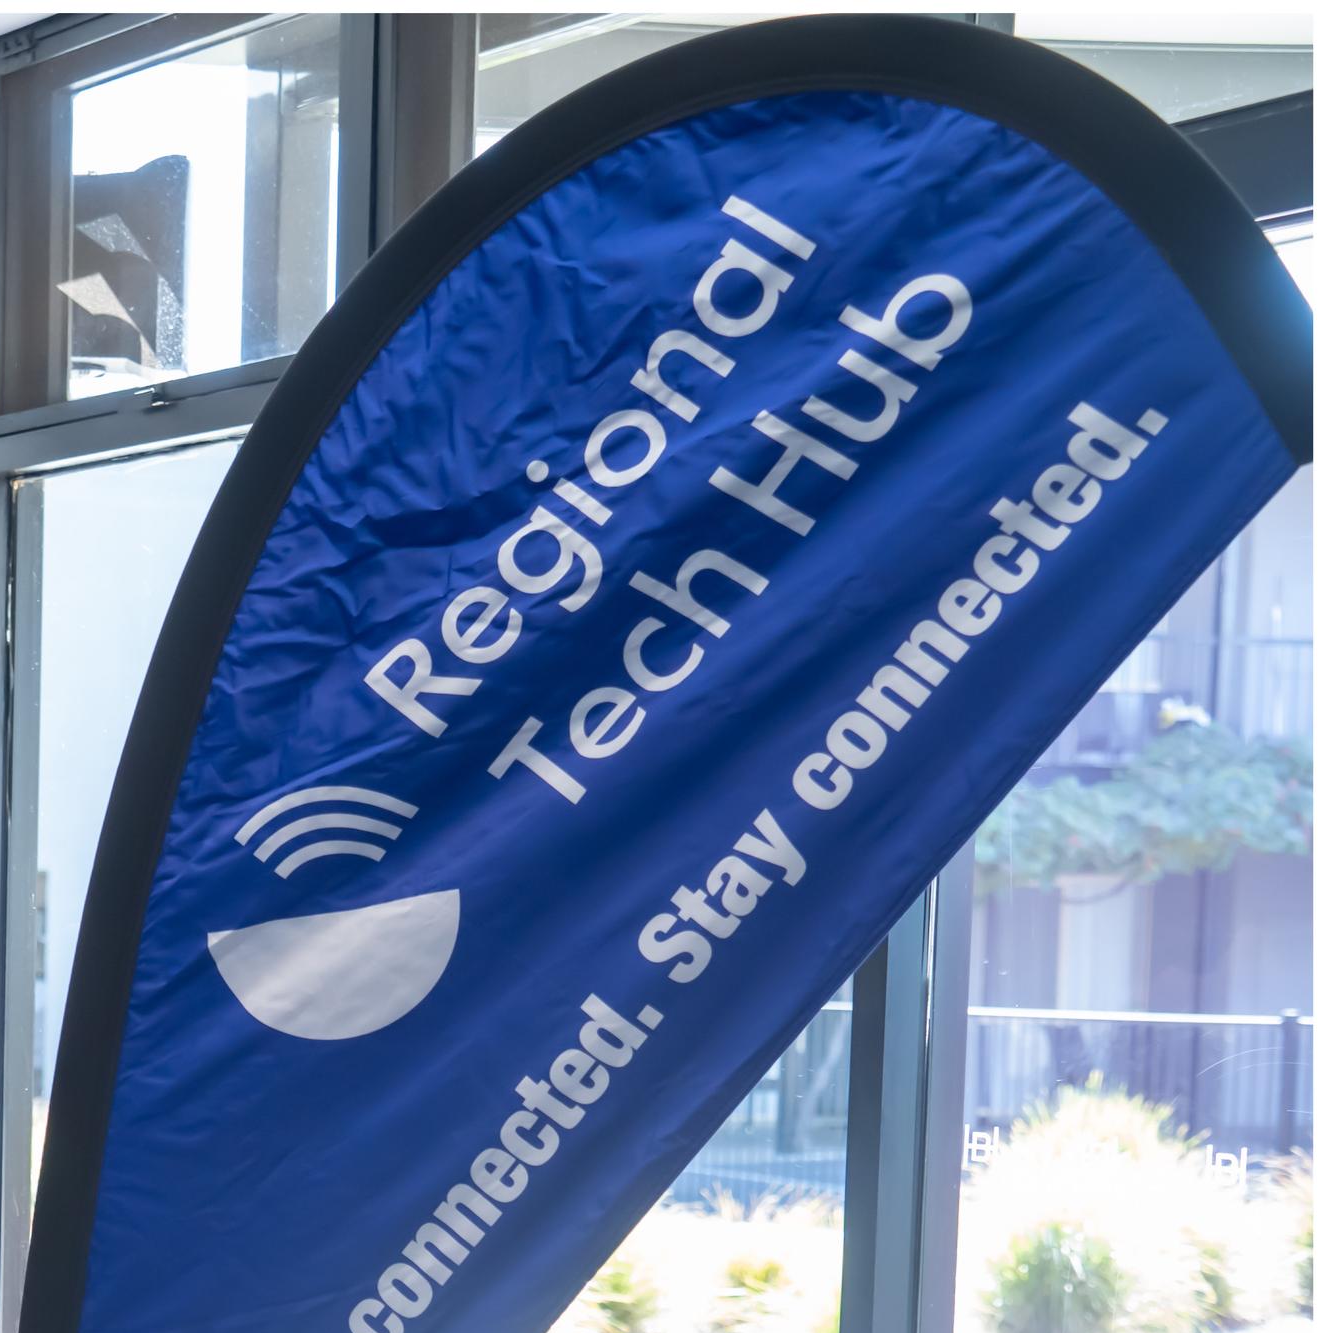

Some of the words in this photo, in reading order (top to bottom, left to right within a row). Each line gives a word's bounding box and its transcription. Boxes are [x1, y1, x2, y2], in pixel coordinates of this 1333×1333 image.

[363, 195, 818, 740] Regional
[488, 547, 771, 806] Tech
[708, 272, 974, 536] Hub
[637, 808, 810, 985] Stay
[791, 401, 1171, 813] connected.
